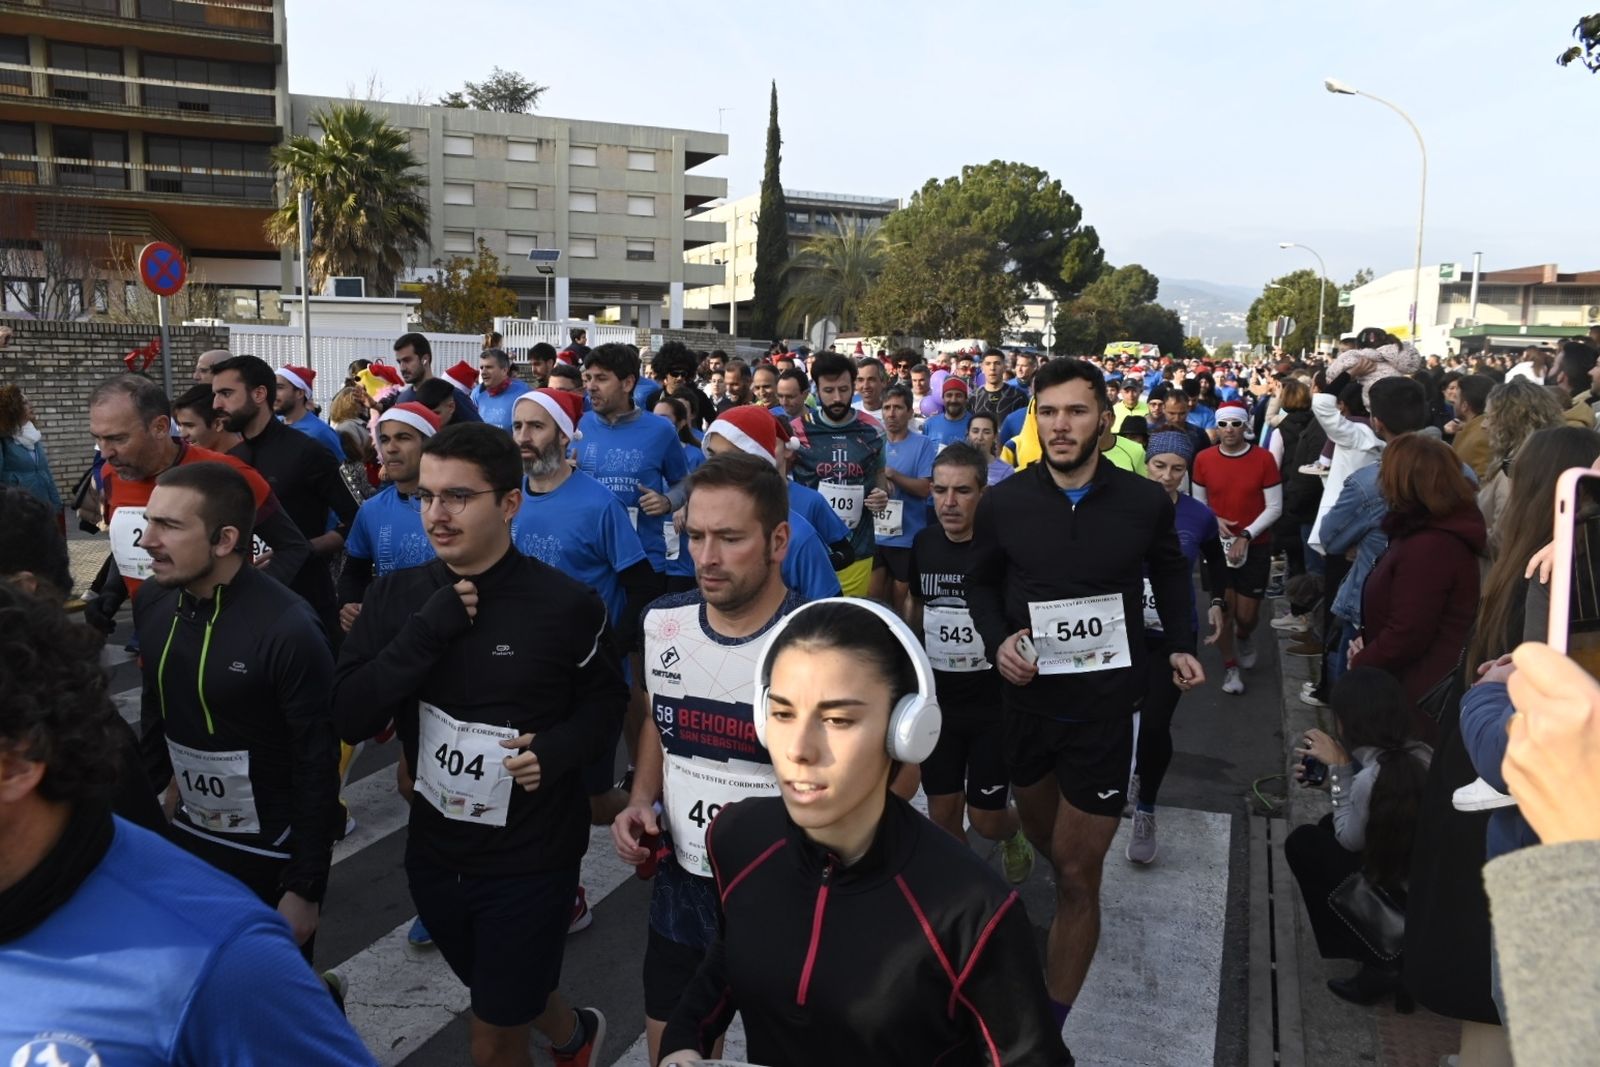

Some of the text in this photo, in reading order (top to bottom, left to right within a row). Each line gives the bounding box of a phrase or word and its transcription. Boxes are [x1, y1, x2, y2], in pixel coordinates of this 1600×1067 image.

[607, 484, 635, 492] OBESA
[830, 497, 854, 510] 103
[940, 625, 974, 644] 543
[1057, 616, 1103, 642] 540
[651, 668, 682, 681] FORTUNA
[656, 704, 674, 723] 58
[678, 708, 756, 741] BEHOBIA
[679, 729, 699, 742] SAN
[435, 743, 485, 781] 404
[182, 769, 225, 798] 140
[692, 770, 727, 785] SILVESTRE
